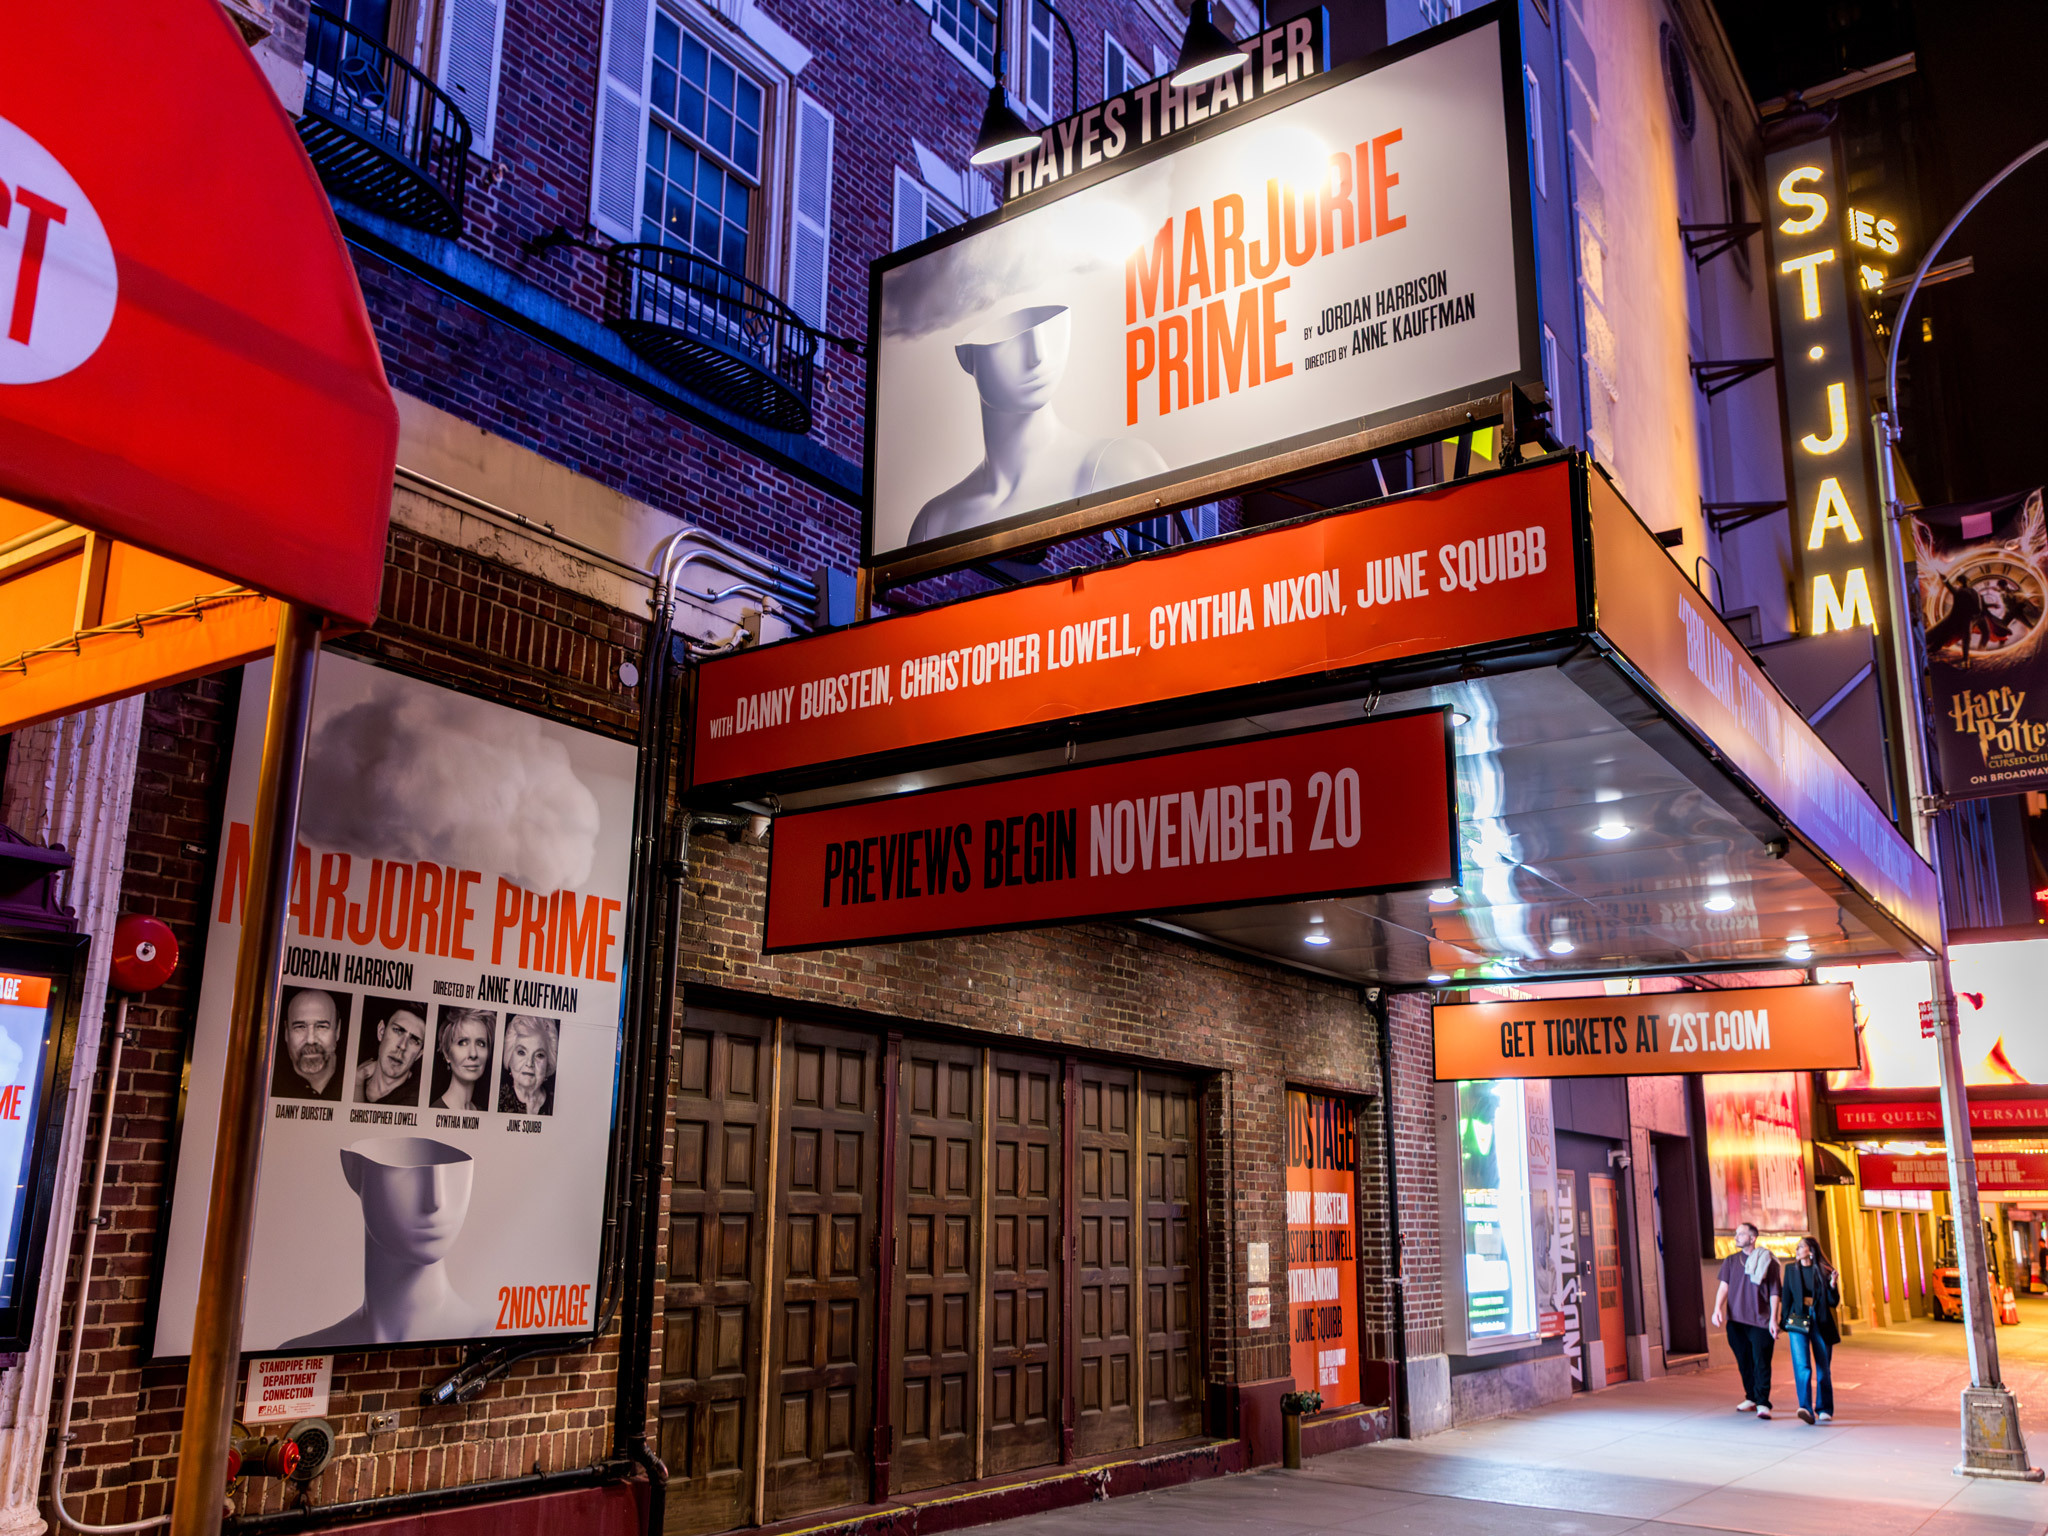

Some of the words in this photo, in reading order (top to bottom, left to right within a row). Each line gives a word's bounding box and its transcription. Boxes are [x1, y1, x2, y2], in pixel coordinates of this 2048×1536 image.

[1009, 103, 1126, 199] HAYES
[1139, 17, 1315, 144] THEATER
[1124, 127, 1407, 325] MARJORIE
[1849, 207, 1900, 254] ES
[1304, 325, 1314, 340] BY
[1317, 294, 1372, 337] JORDAN
[1376, 269, 1448, 321] HARRISON
[1125, 276, 1293, 426] PRIME
[1305, 348, 1336, 371] DIRECTED
[1338, 344, 1348, 361] BY
[1352, 321, 1389, 357] ANNE
[1392, 292, 1476, 344] KAUFFMAN
[709, 714, 733, 740] WITH
[736, 686, 796, 735] DANNY
[799, 665, 894, 721] BURSTEIN,
[900, 633, 1040, 700] CHRISTOPHER
[1047, 609, 1141, 671] LOWELL,
[1149, 587, 1255, 650] CYNTHIA
[1263, 568, 1348, 628] NIXON,
[1357, 549, 1429, 609] JUNE
[1439, 525, 1547, 592] SQUIBB
[1948, 686, 2026, 733] Harry
[1975, 717, 2048, 767] Potte
[1989, 756, 2028, 769] CURSED
[1970, 775, 1987, 784] ON
[1990, 766, 2048, 782] BROADWAY
[823, 823, 972, 908] PREVIEWS
[984, 808, 1077, 890] BEGIN
[1090, 778, 1293, 878] NOVEMBER
[1308, 767, 1361, 851] 20
[218, 821, 482, 961] MARJORIE
[492, 876, 621, 983] PRIME
[283, 945, 341, 984] JORDAN
[344, 954, 413, 991] HARRISON
[433, 979, 462, 999] DIRECTED
[463, 983, 474, 1000] BY
[477, 974, 510, 1004] ANNE
[513, 977, 577, 1013] KAUFFMAN
[1501, 1020, 1536, 1058] GET
[1543, 1015, 1627, 1057] TICKETS
[1636, 1014, 1660, 1053] AT
[1668, 1009, 1770, 1053] 2ST.COM
[275, 1105, 299, 1122] DANNY
[300, 1105, 333, 1123] BURSTEIN
[350, 1108, 390, 1126] CHRISTOPHER
[392, 1111, 417, 1128] LOWELL
[436, 1115, 459, 1130] CYNTHIA
[460, 1116, 479, 1131] NIXON
[506, 1119, 521, 1133] JUNE
[523, 1120, 542, 1134] SQUIBB
[1844, 1113, 1876, 1123] THE
[1882, 1110, 1937, 1124] QUEEN
[1287, 1191, 1311, 1224] DANNY
[1314, 1192, 1348, 1224] BURSTEIN
[1325, 1230, 1353, 1262] LOWELL
[496, 1283, 591, 1330] 2NDSTAGE
[1316, 1267, 1339, 1301] NIXON
[1295, 1309, 1315, 1343] JUNE
[1317, 1305, 1342, 1343] SQUIBB
[259, 1360, 304, 1374] STANDPIPE
[305, 1358, 323, 1370] FIRE
[263, 1373, 317, 1387] DEPARTMENT
[263, 1387, 314, 1401] CONNECTION
[266, 1404, 287, 1414] RAEL
